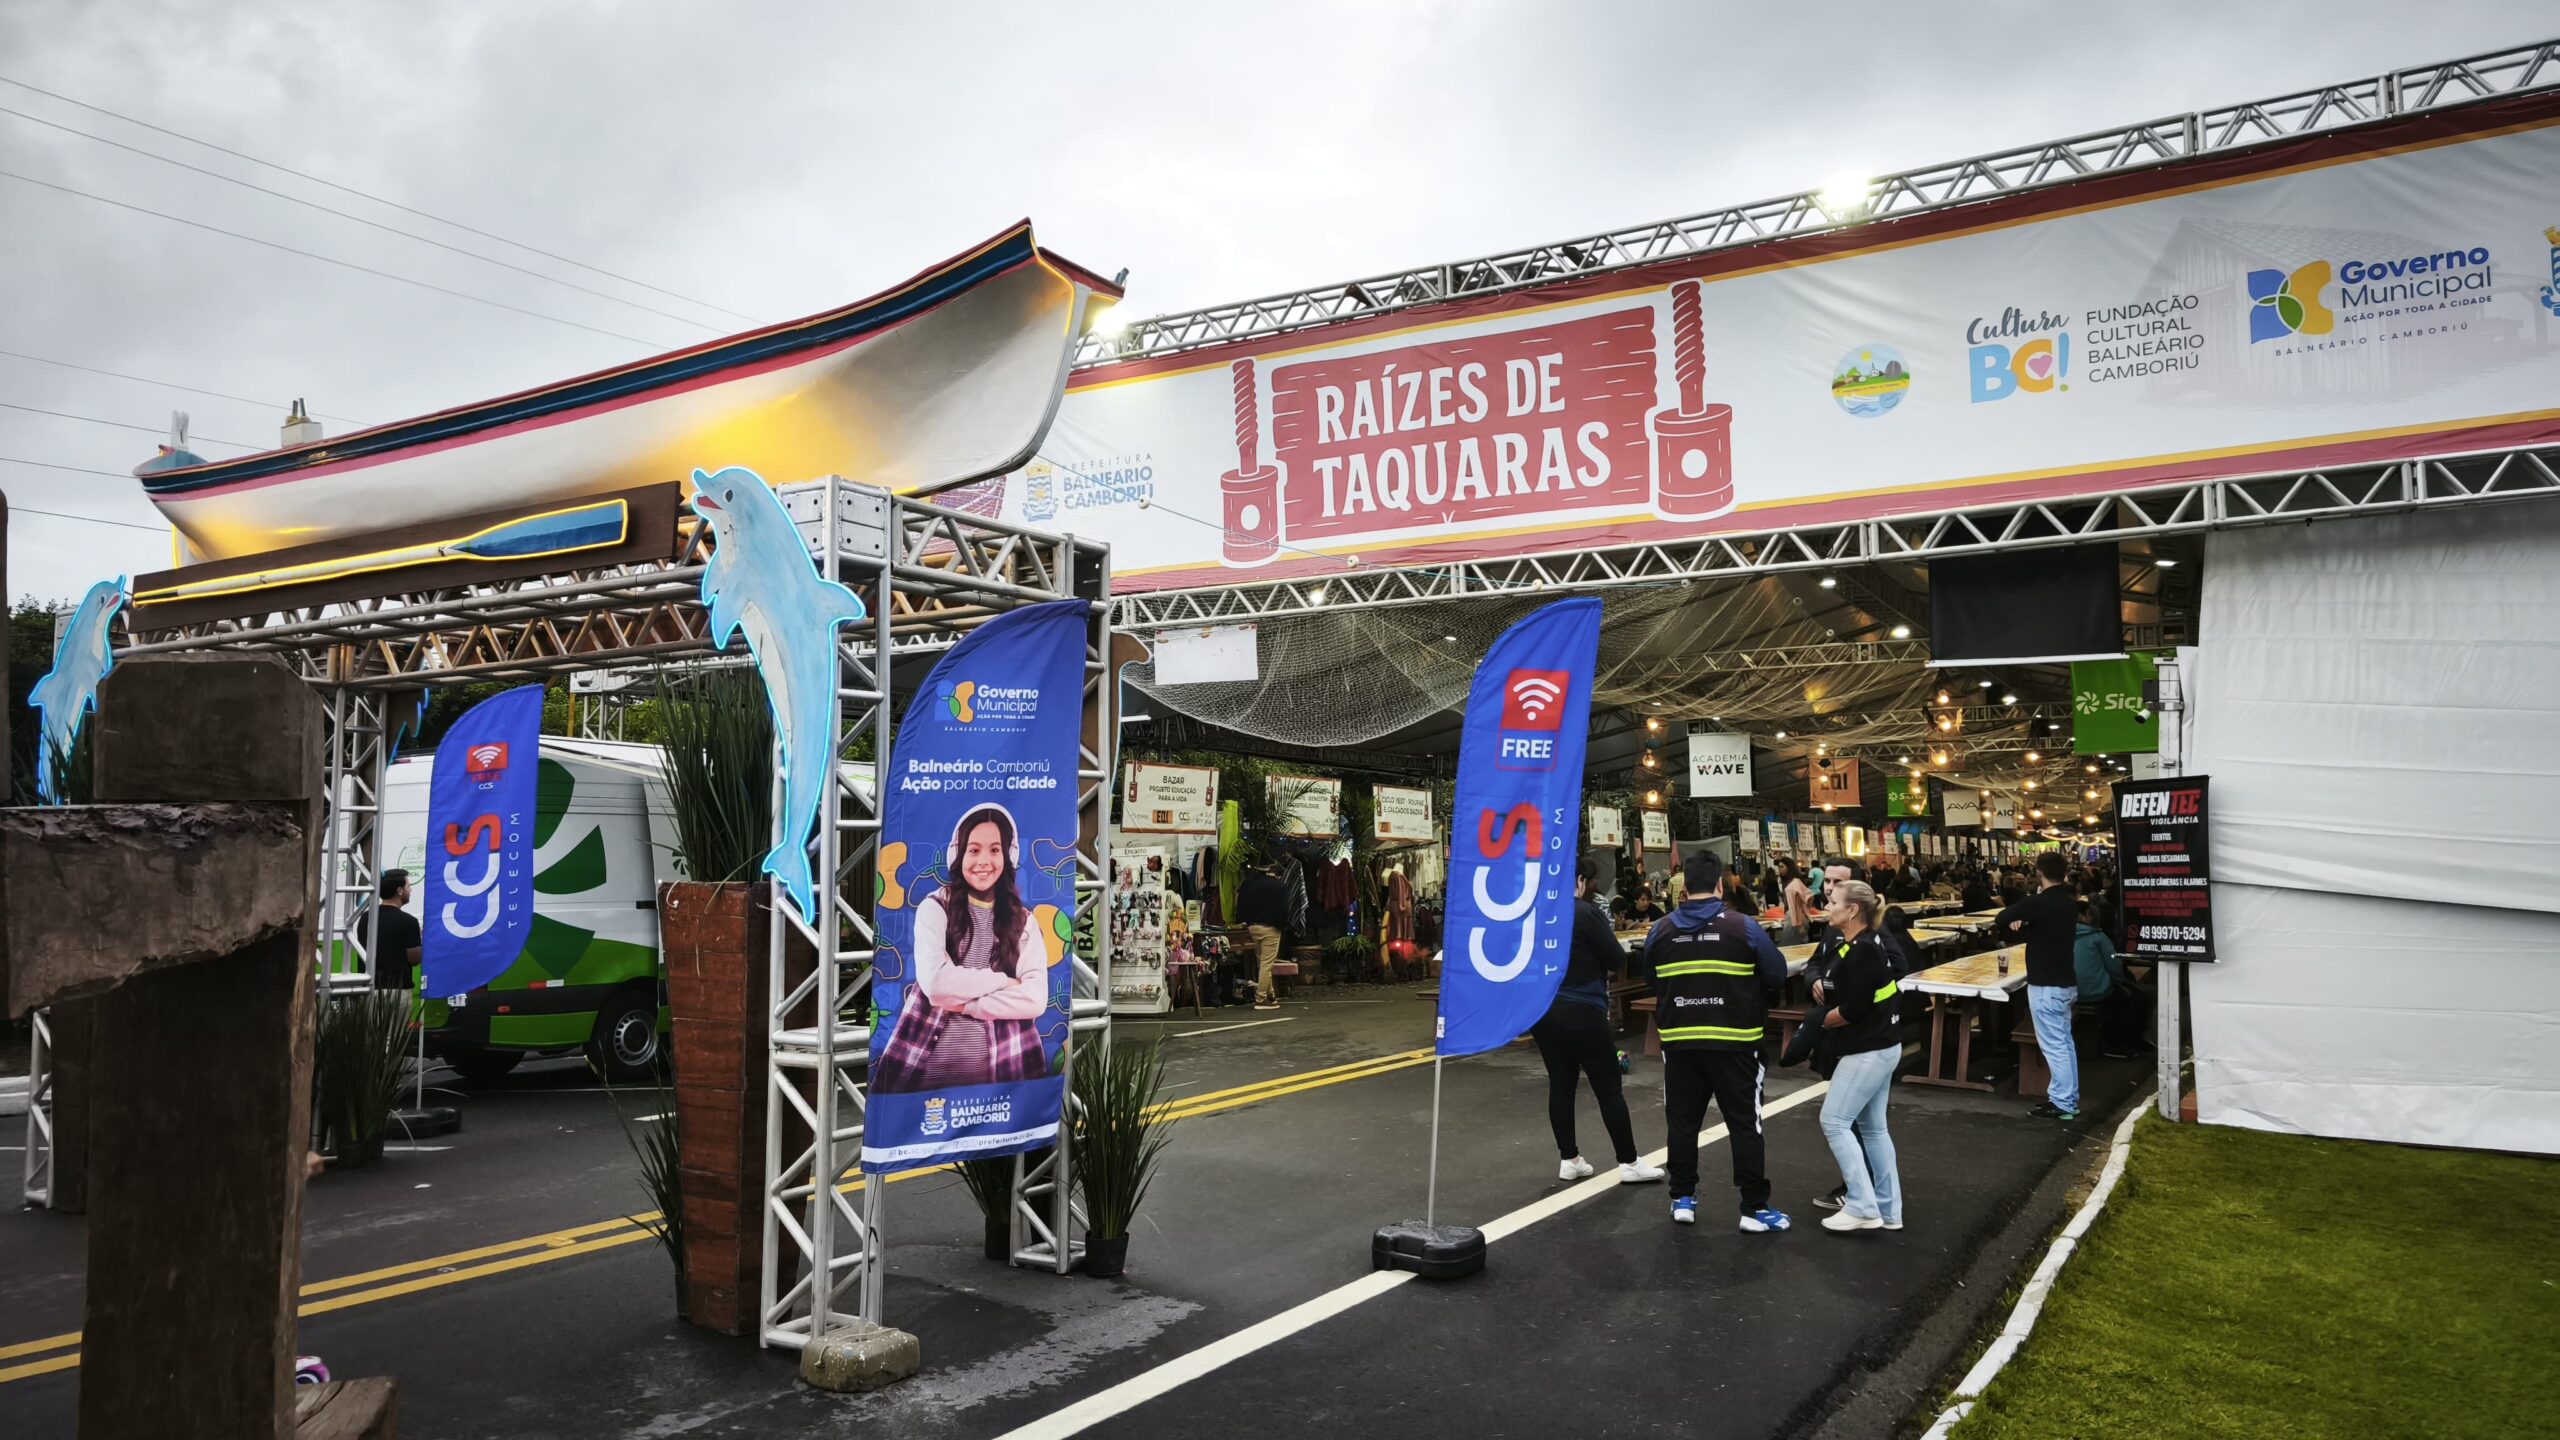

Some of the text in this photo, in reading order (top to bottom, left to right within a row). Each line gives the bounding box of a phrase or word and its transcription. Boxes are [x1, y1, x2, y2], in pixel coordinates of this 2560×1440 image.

[2340, 247, 2489, 284] Governo
[2341, 266, 2492, 309] Municipal
[2086, 294, 2200, 325] FUNDAÇÃO
[2343, 295, 2493, 324] AÇÃO POR TODA A CIDADE
[1966, 306, 2069, 345] Cultura
[2087, 315, 2192, 345] CULTURAL
[2275, 321, 2469, 357] BALNEÁRIO CAMBORIÚ
[2088, 333, 2205, 364] BALNEÁRIO
[1968, 331, 2070, 404] BC!
[2088, 351, 2200, 384] CAMBORIÚ
[1315, 352, 1566, 444] RAÍZES DE
[1062, 453, 1152, 472] PREFEITURA
[1312, 421, 1612, 518] TAQUARAS
[976, 698, 1038, 714] Municipal
[978, 684, 1039, 699] Governo
[1501, 737, 1553, 760] FREE
[1692, 752, 1749, 763] ACADEMIA
[908, 758, 1050, 774] Balneário Camboriú
[1162, 775, 1185, 784] BAZAR
[1697, 763, 1745, 776] WAVE
[478, 782, 494, 790] CCS
[900, 776, 1057, 794] Ação por toda Cidade
[2120, 789, 2202, 818] DEFENTEC
[2150, 815, 2199, 825] VIGILÂNCIA
[441, 813, 502, 940] CCS
[508, 812, 521, 929] TELECOM
[1468, 802, 1543, 983] CCS
[1544, 807, 1565, 976] TELECOM
[2139, 925, 2206, 940] 49 99970-5294
[1709, 997, 1724, 1005] 156
[950, 1094, 1011, 1107] PREFEITURA
